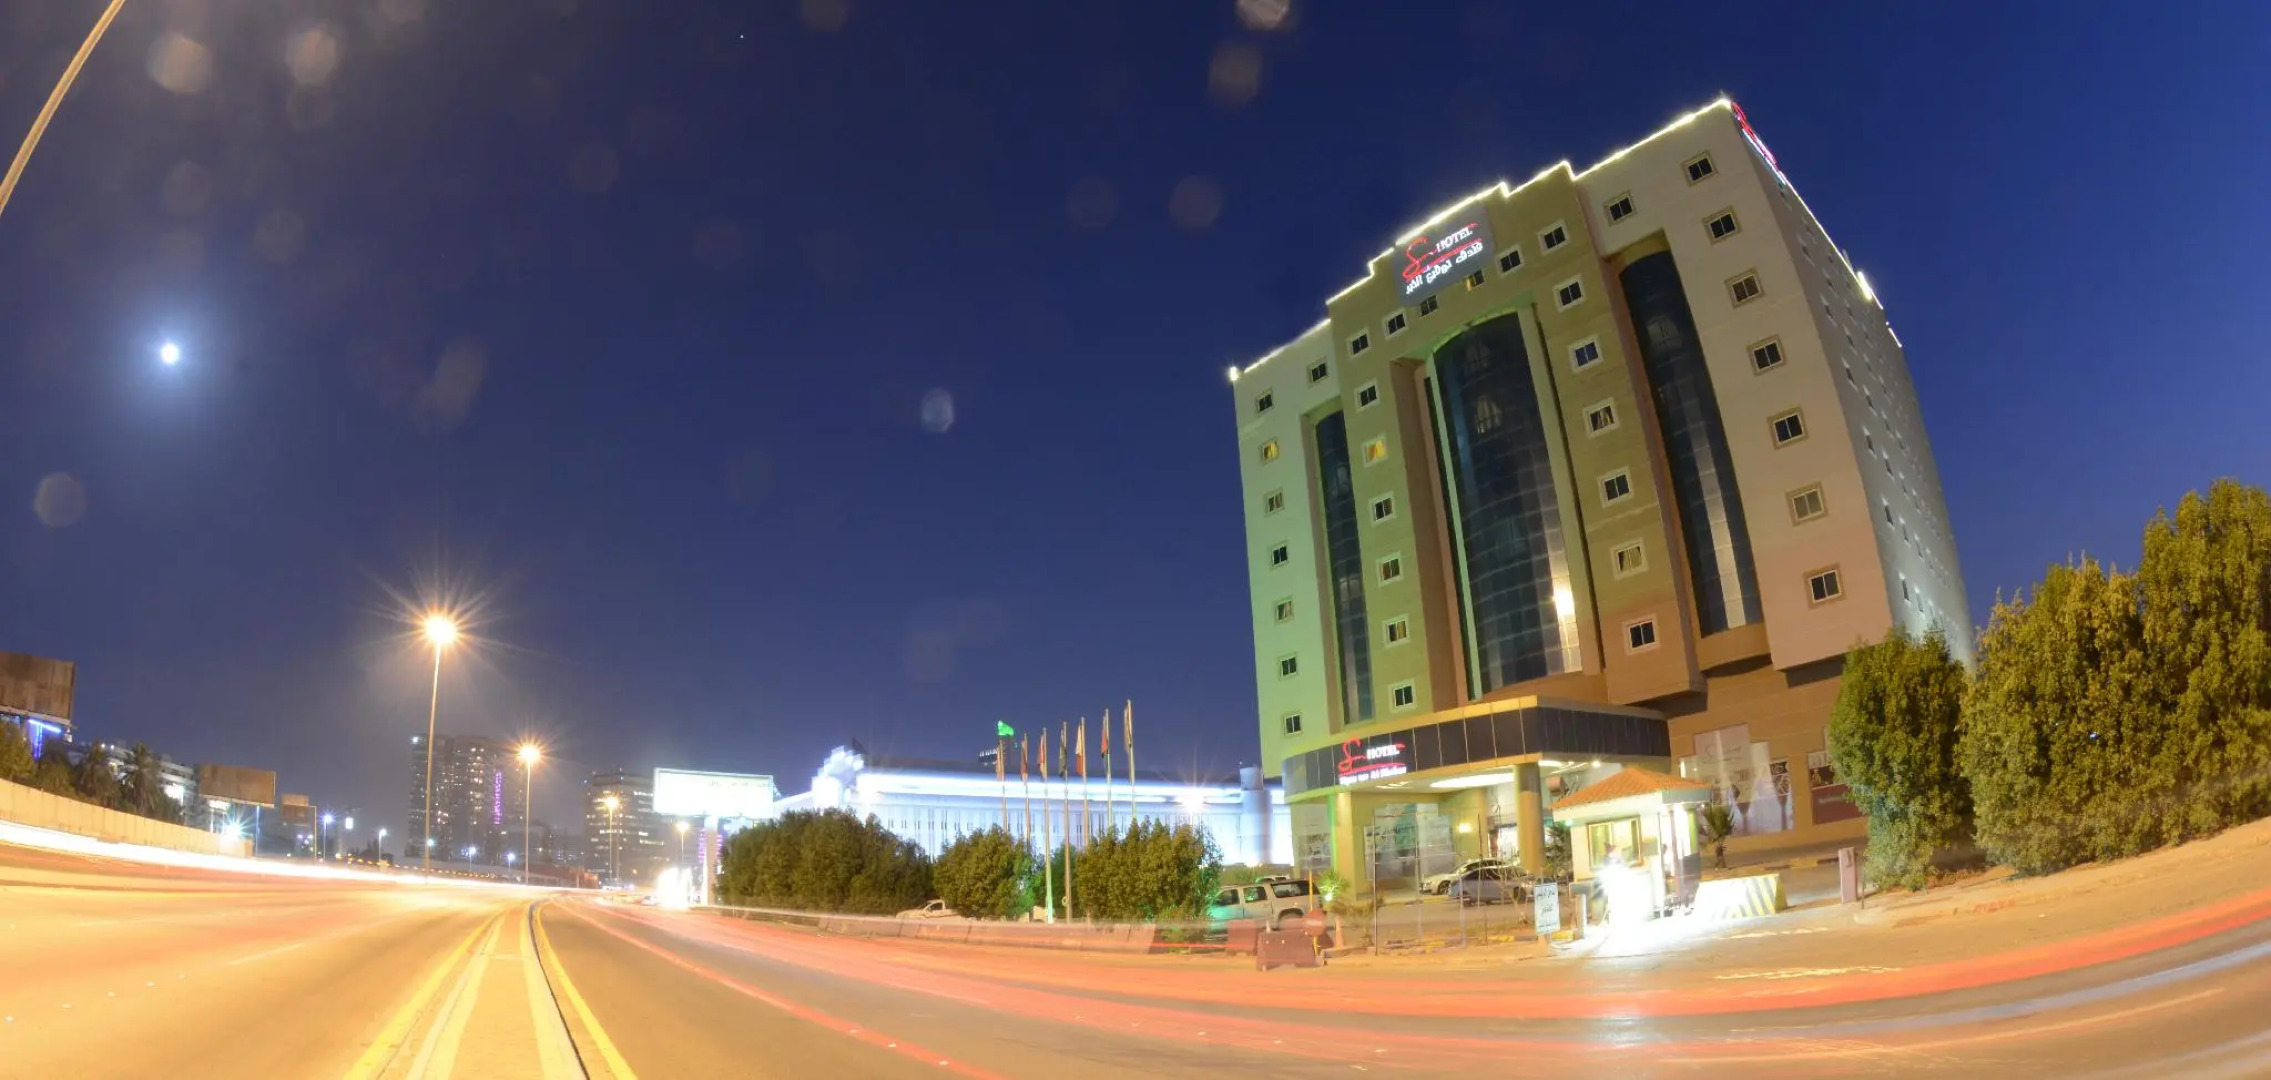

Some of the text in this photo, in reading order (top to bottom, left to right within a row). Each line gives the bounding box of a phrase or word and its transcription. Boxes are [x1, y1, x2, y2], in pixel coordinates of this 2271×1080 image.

[1436, 227, 1473, 252] HOTEL
[1456, 242, 1483, 264] فندق
[1366, 744, 1400, 760] HOTEL
